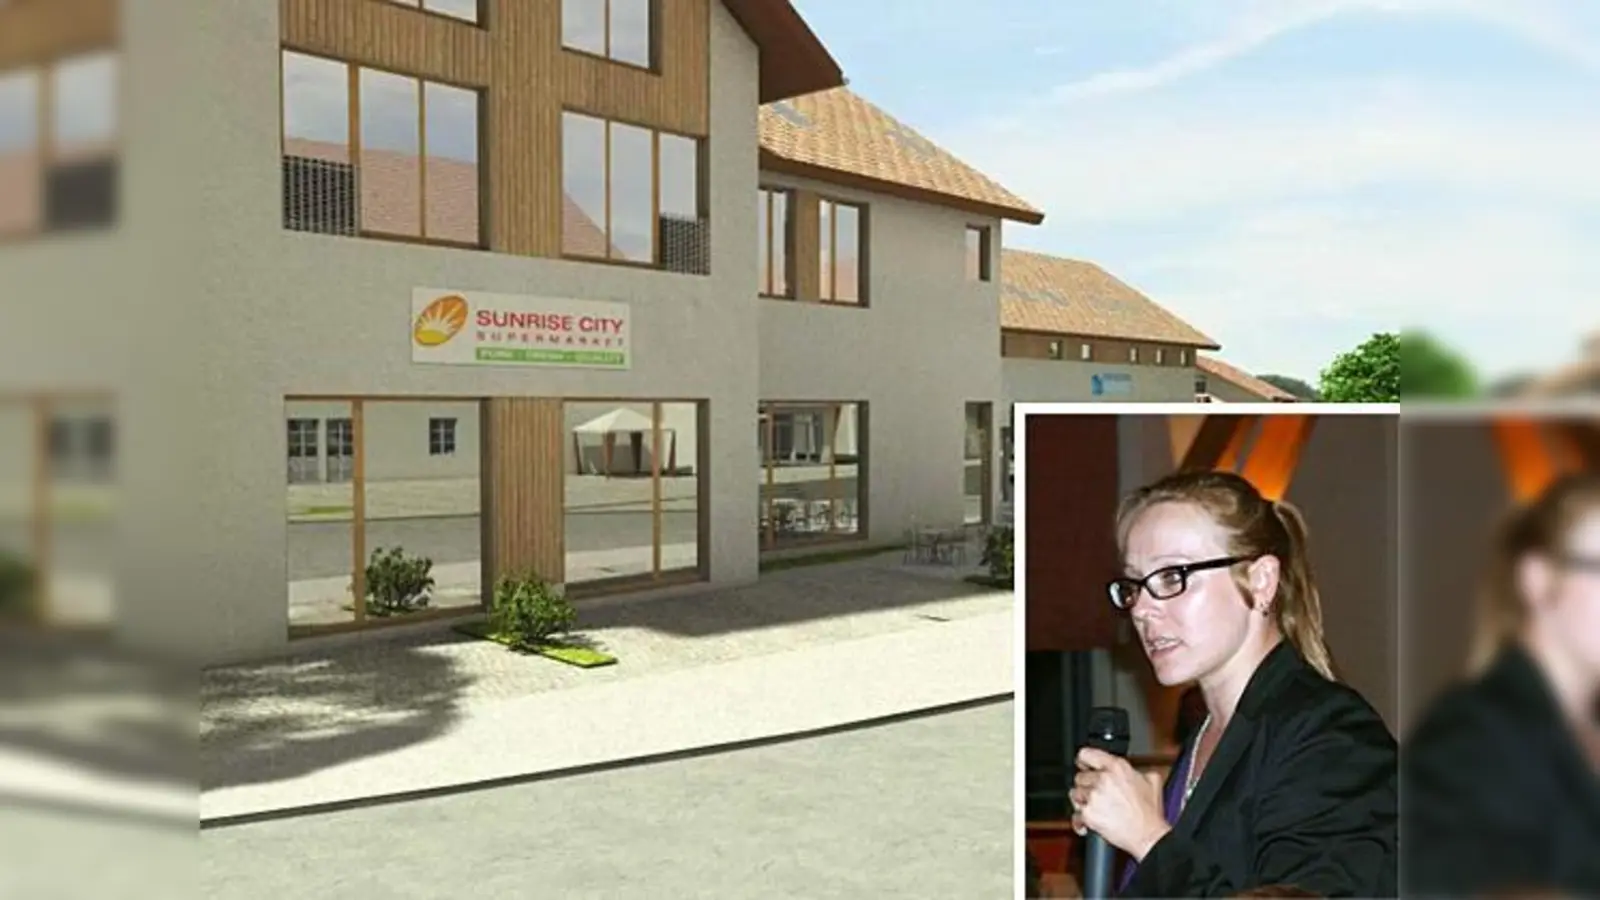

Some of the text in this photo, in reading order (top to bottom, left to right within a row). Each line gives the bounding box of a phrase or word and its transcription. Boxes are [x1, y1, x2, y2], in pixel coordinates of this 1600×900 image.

[476, 309, 624, 335] SUNRISE CITY
[476, 331, 623, 347] SUPERMARKET
